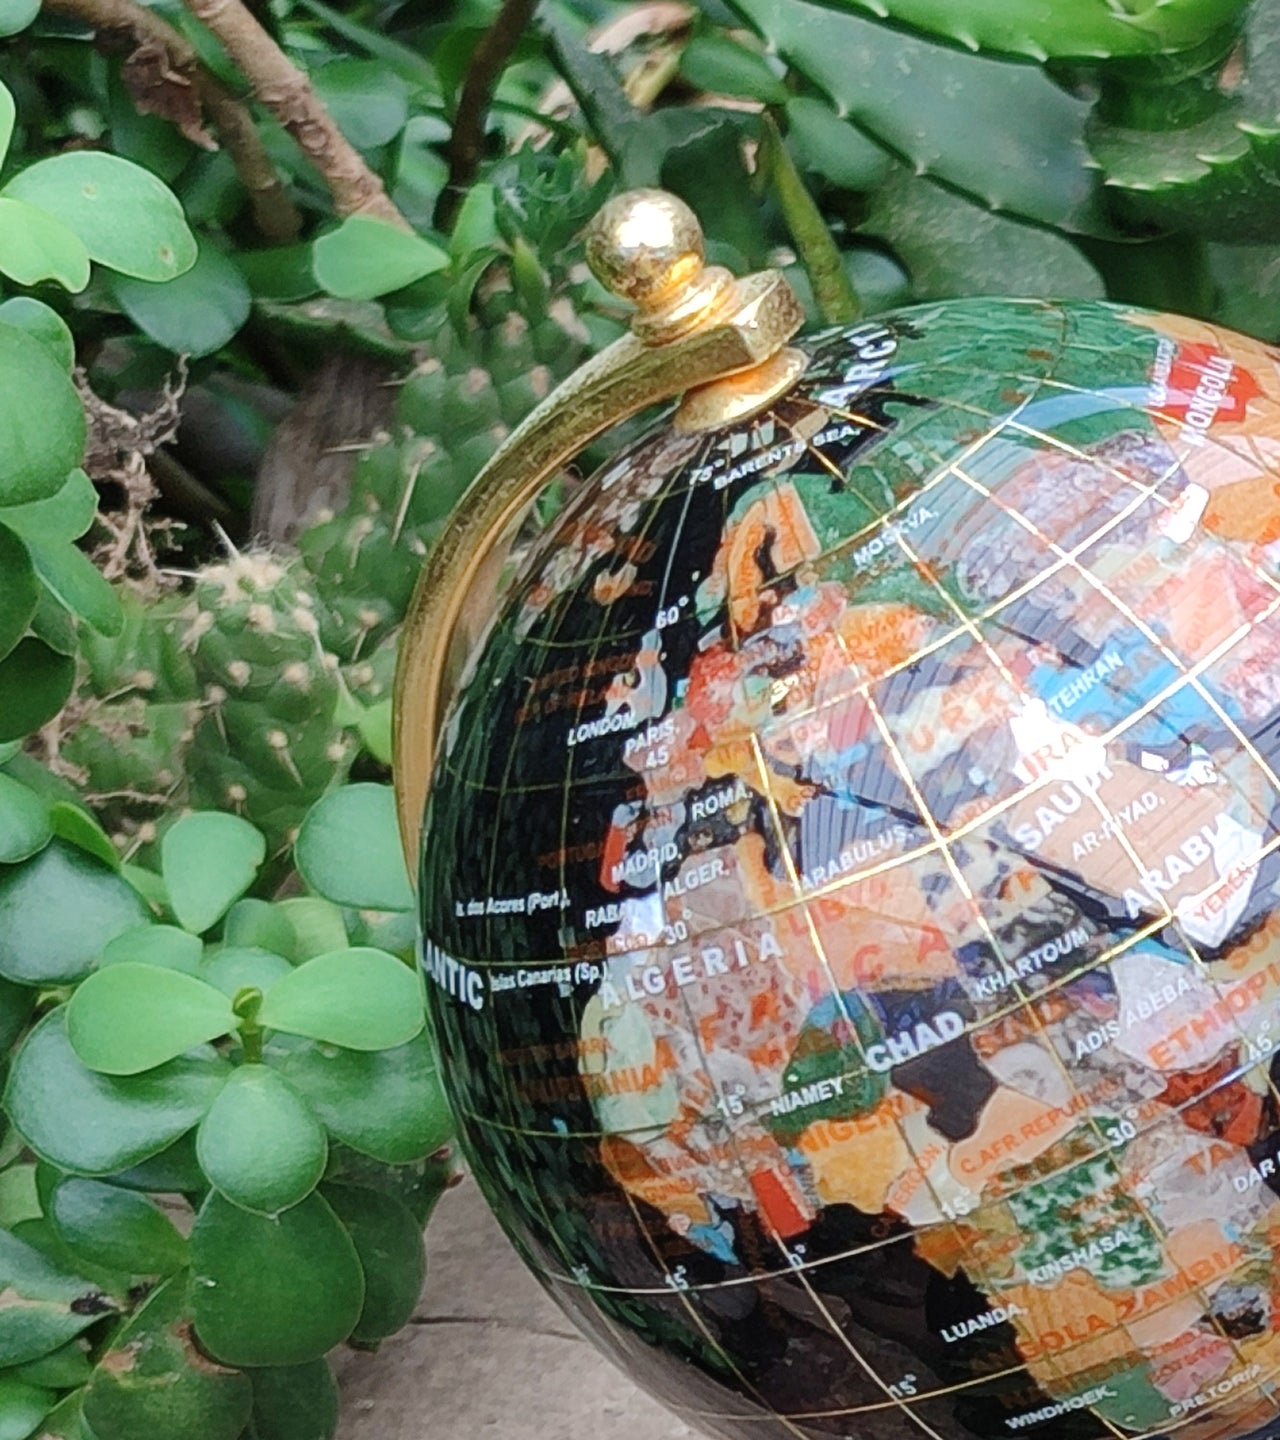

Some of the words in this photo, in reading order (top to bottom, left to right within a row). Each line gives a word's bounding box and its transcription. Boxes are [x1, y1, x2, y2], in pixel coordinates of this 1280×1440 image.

[1049, 650, 1124, 713] TEHRAN
[597, 931, 786, 1011] ALGERIA
[973, 925, 1092, 999] KHARTOUM
[865, 1010, 966, 1073] CHAD
[1075, 1020, 1121, 1062] ADIS
[769, 1076, 845, 1117] NIAMEY
[1233, 1156, 1277, 1194] DAR
